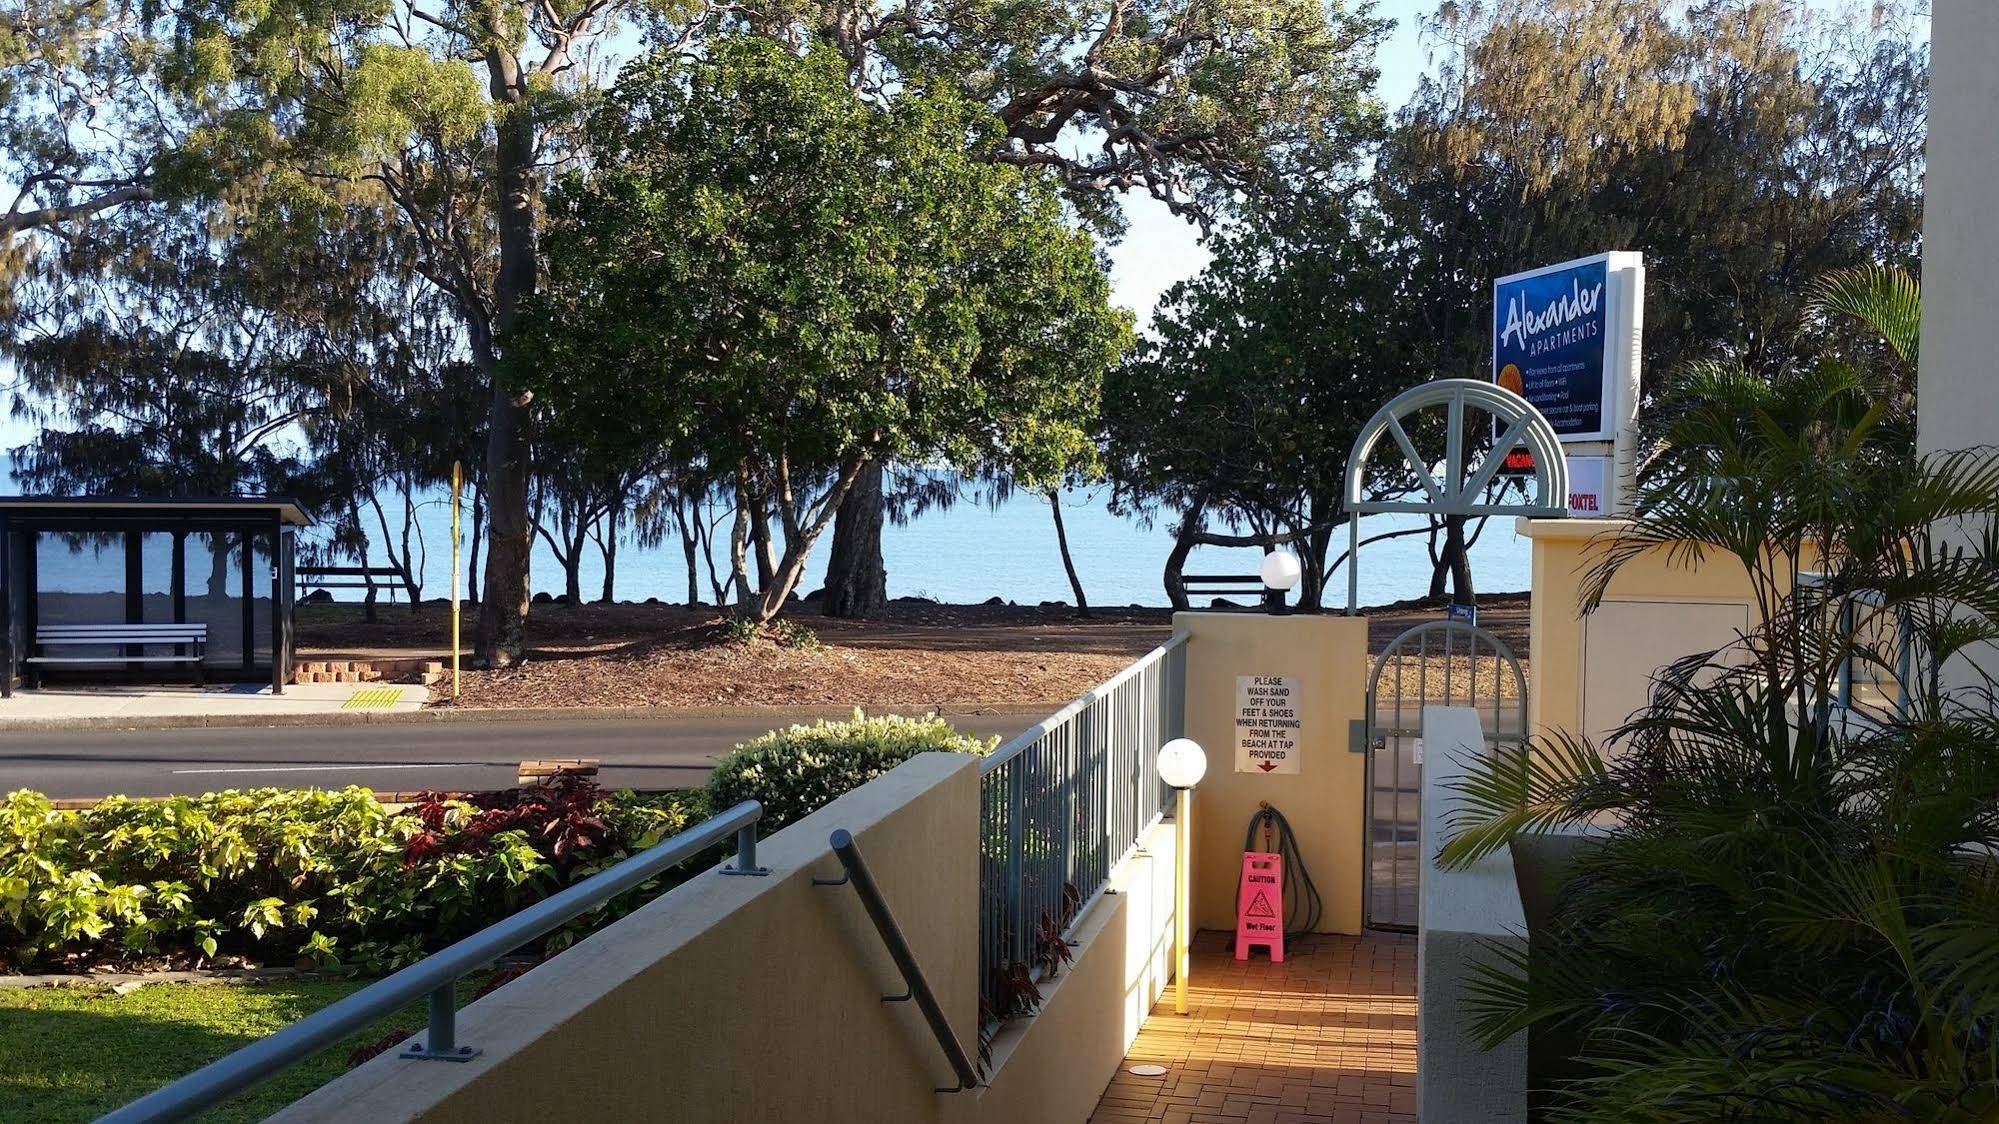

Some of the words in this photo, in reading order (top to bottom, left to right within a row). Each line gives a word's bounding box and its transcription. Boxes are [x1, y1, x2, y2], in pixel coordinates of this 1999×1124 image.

[1501, 277, 1602, 351] Alexander
[1530, 320, 1597, 357] APARTMENTS
[1254, 677, 1282, 686] PLEASE
[1247, 688, 1268, 696] WASH
[1269, 688, 1289, 697] SAND
[1266, 699, 1286, 707] YOUR
[1262, 709, 1267, 717] &
[1236, 719, 1257, 727] WHEN
[1259, 720, 1300, 728] RETURNING
[1250, 730, 1270, 738] FROM
[1272, 730, 1286, 739] THE
[1242, 740, 1266, 748] BEACH
[1280, 741, 1293, 749] TAP
[1249, 750, 1285, 759] PROVIDED
[1248, 875, 1275, 884] CAUTION
[1246, 922, 1258, 931] Wet
[1259, 923, 1276, 931] Floor
